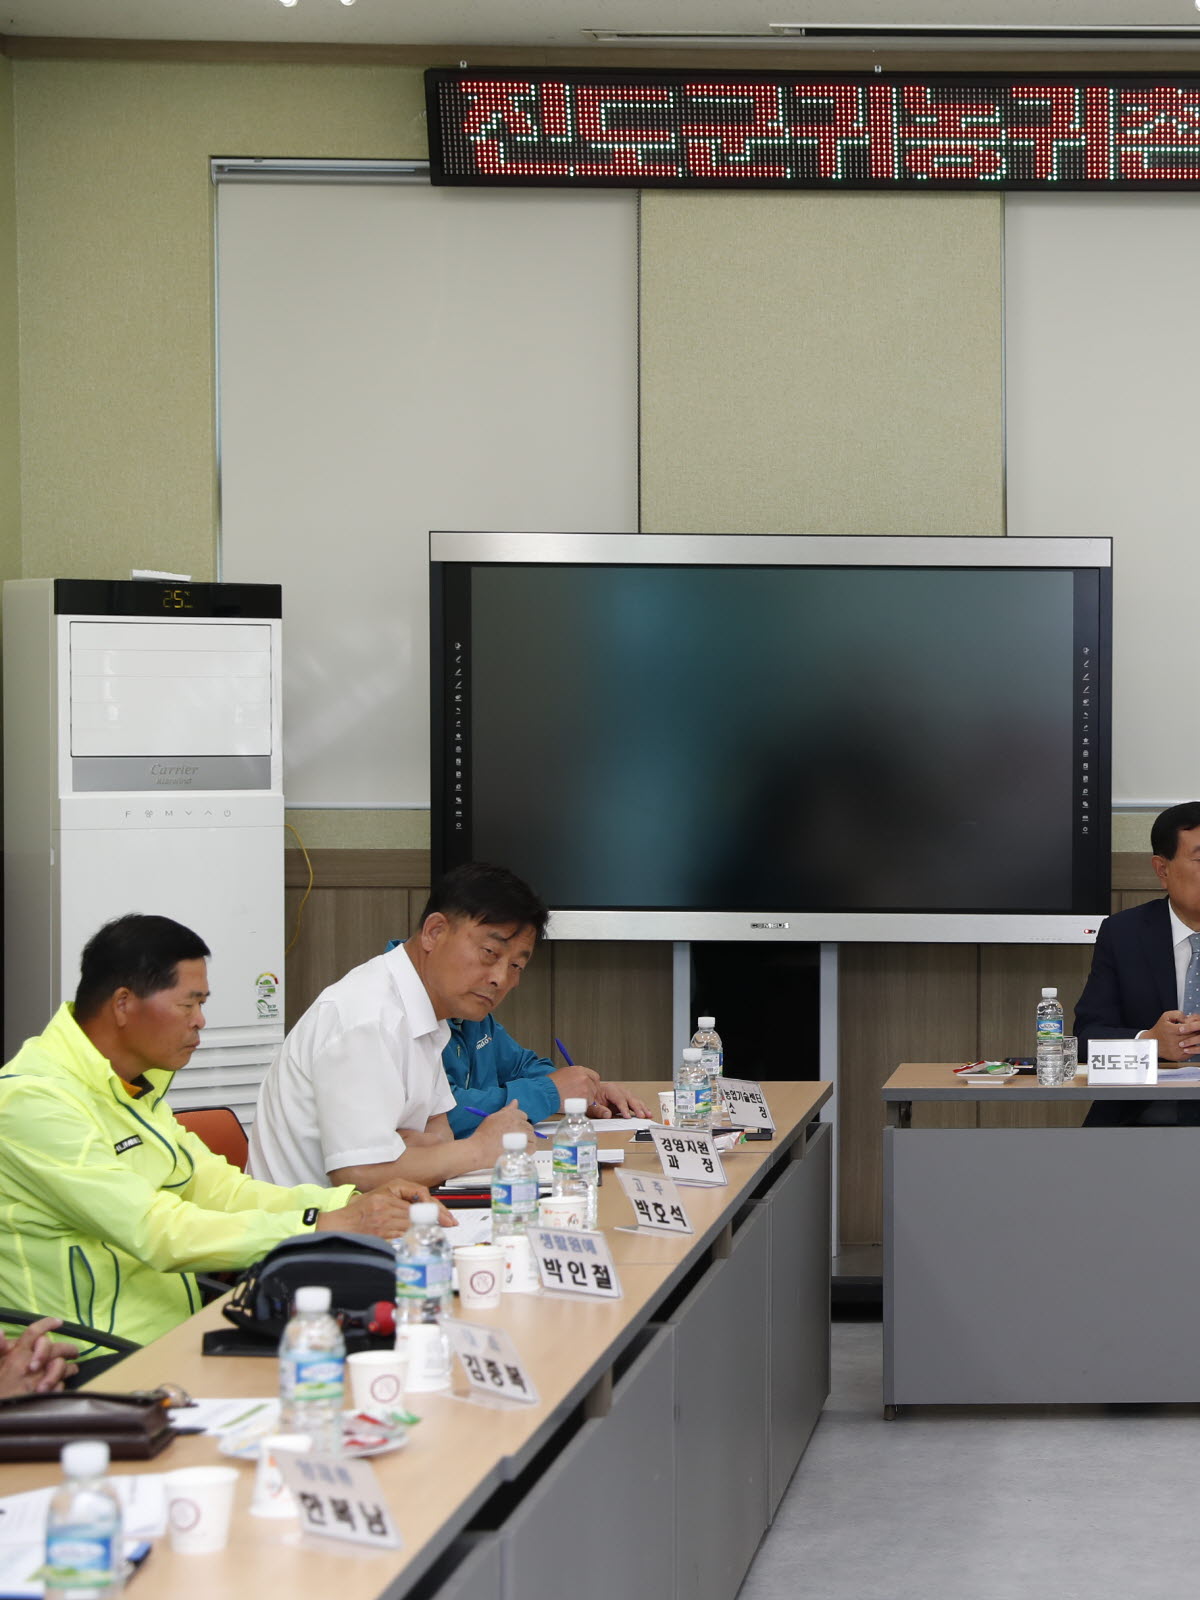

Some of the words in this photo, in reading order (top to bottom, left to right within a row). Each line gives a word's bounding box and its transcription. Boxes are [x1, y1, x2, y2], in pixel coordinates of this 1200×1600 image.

[151, 763, 199, 775] Carrier
[1091, 1054, 1150, 1070] 진도군수
[660, 1137, 710, 1155] 경영지원
[634, 1199, 687, 1227] 박호석
[543, 1257, 612, 1289] 박인철
